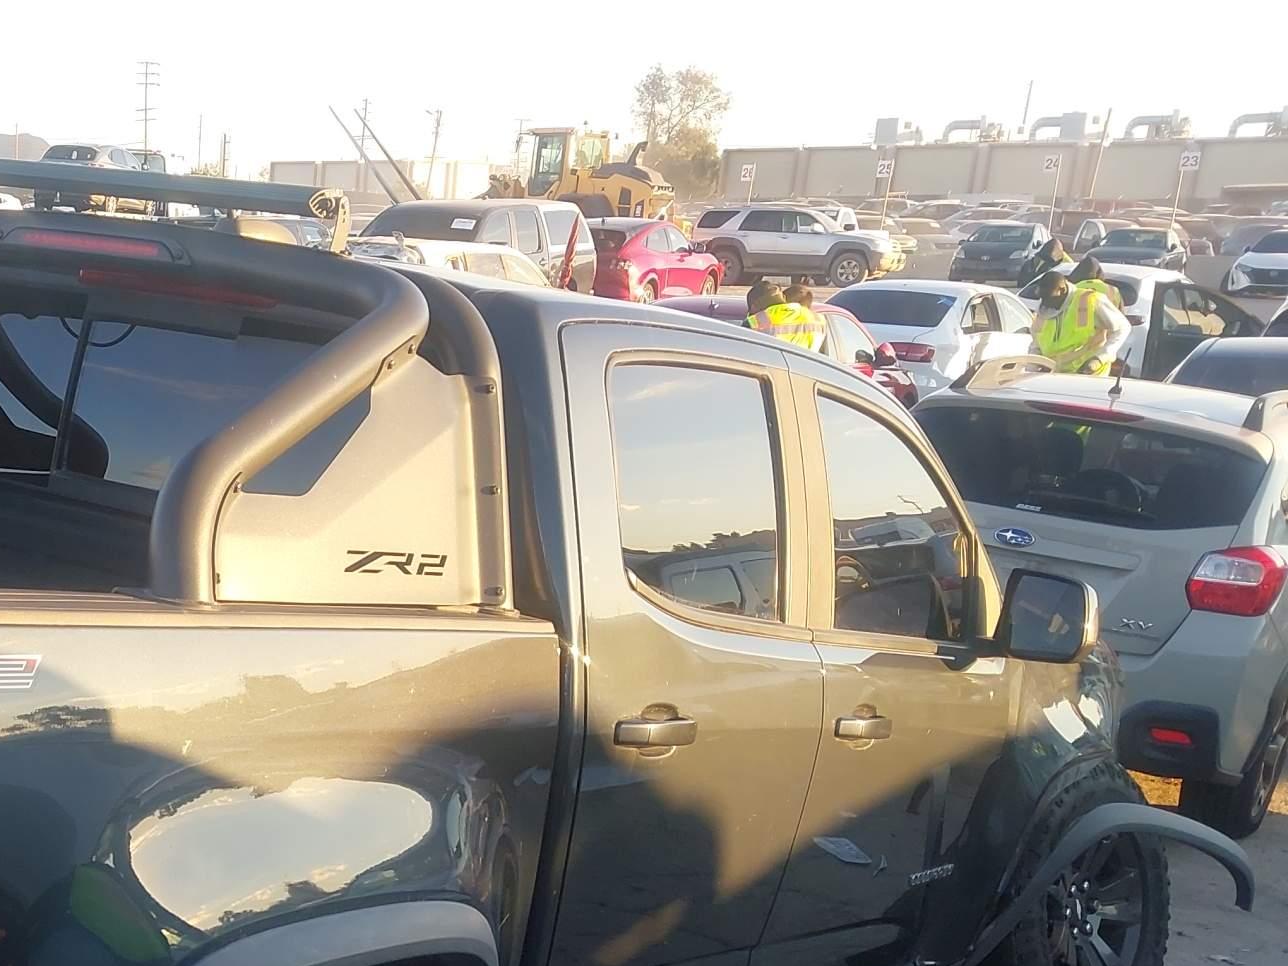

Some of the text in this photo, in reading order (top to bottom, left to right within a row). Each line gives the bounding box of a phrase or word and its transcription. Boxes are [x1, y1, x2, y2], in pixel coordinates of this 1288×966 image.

[1181, 155, 1199, 167] 23
[343, 549, 448, 577] ZR2
[1119, 617, 1153, 630] XV
